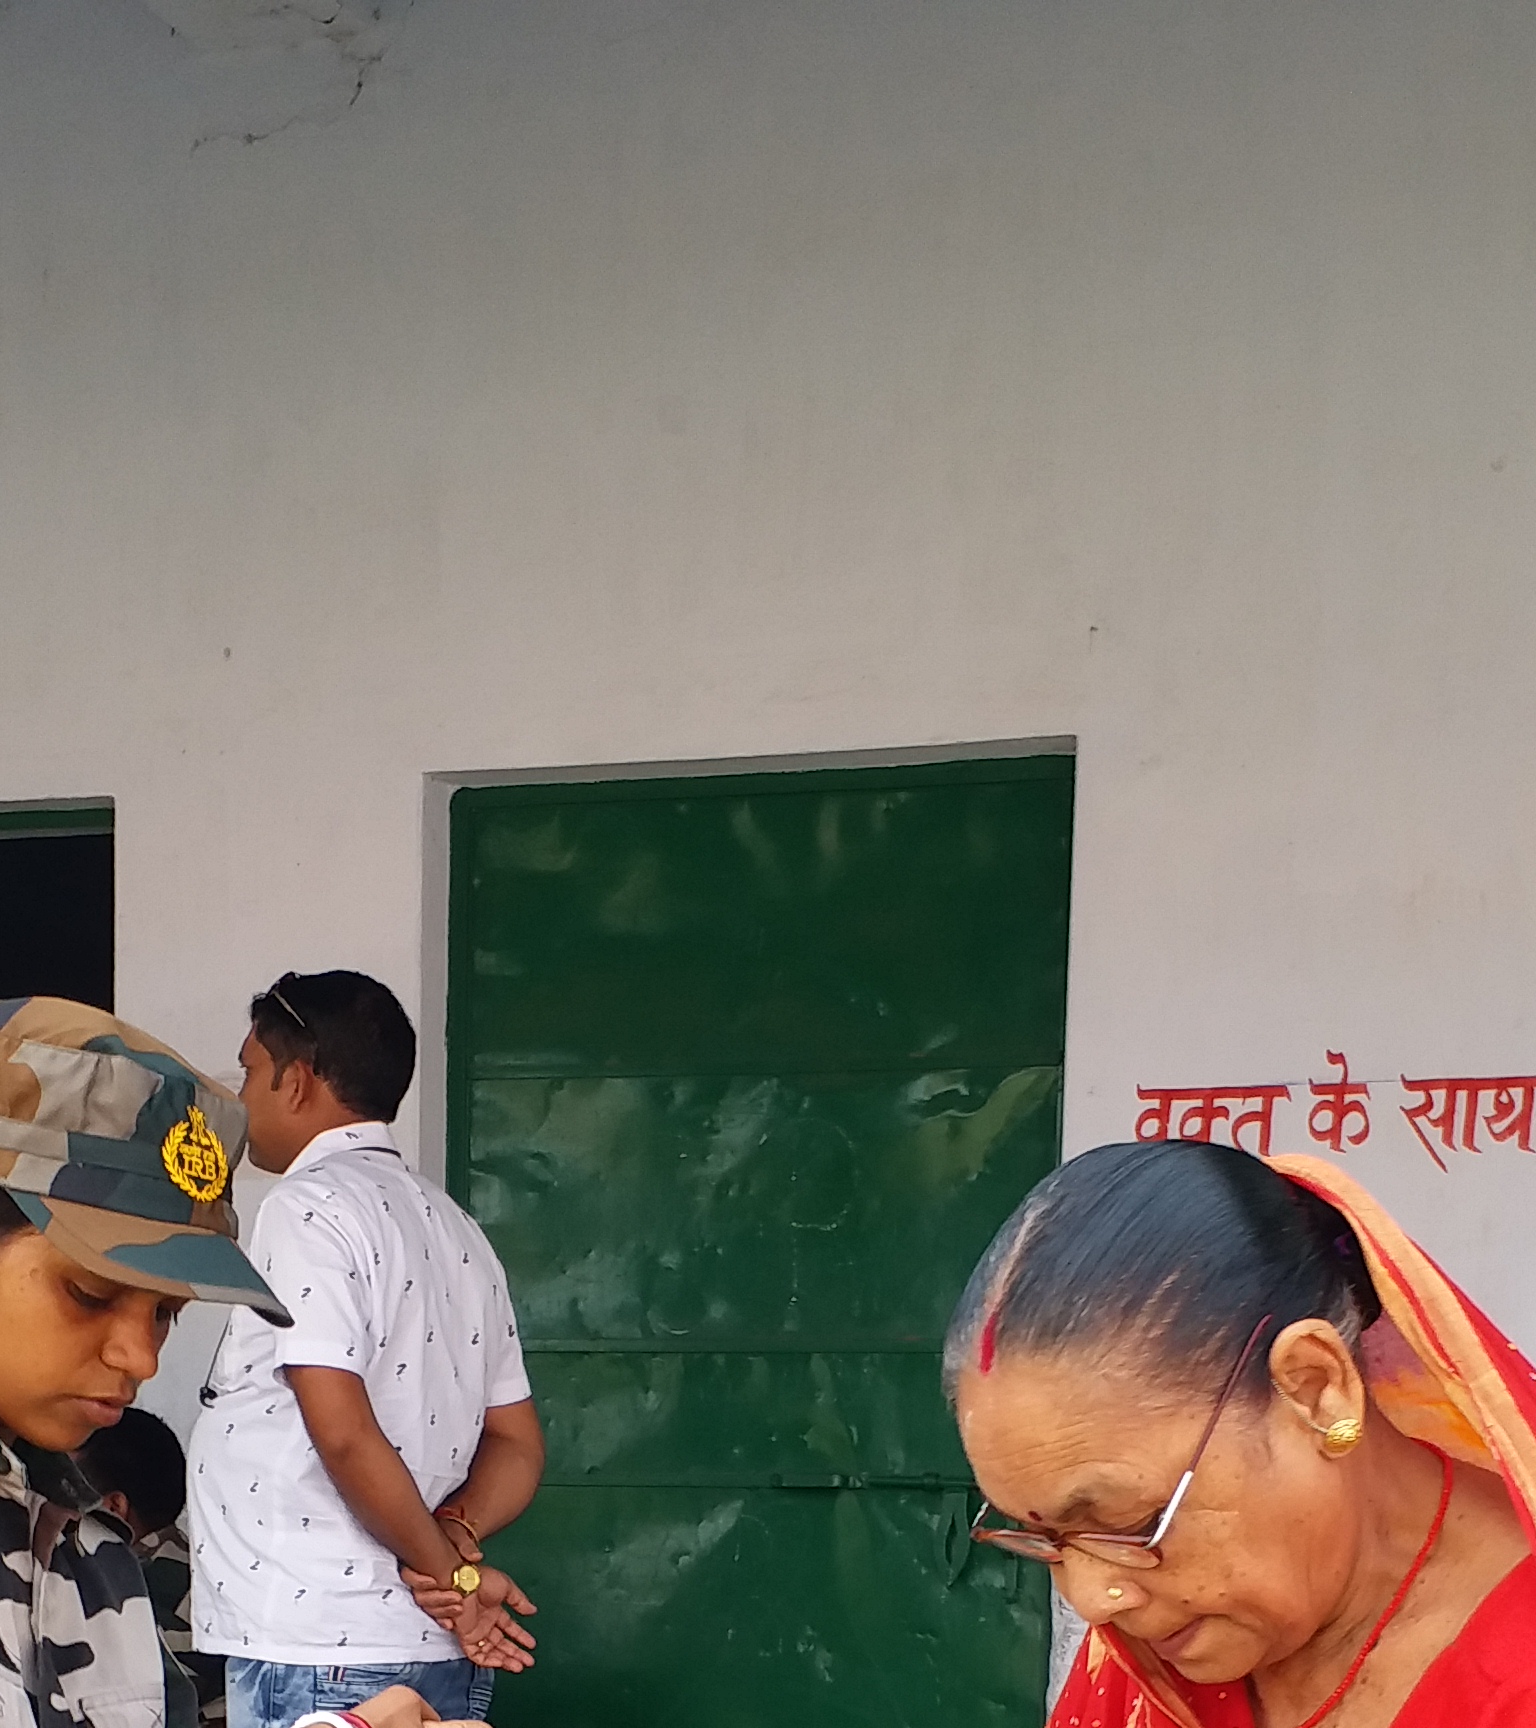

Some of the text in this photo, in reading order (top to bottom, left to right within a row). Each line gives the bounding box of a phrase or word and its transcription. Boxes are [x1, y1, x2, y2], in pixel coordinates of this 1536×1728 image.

[1135, 1084, 1292, 1157] वक्त
[1310, 1053, 1372, 1154] के
[182, 1153, 217, 1181] IRB
